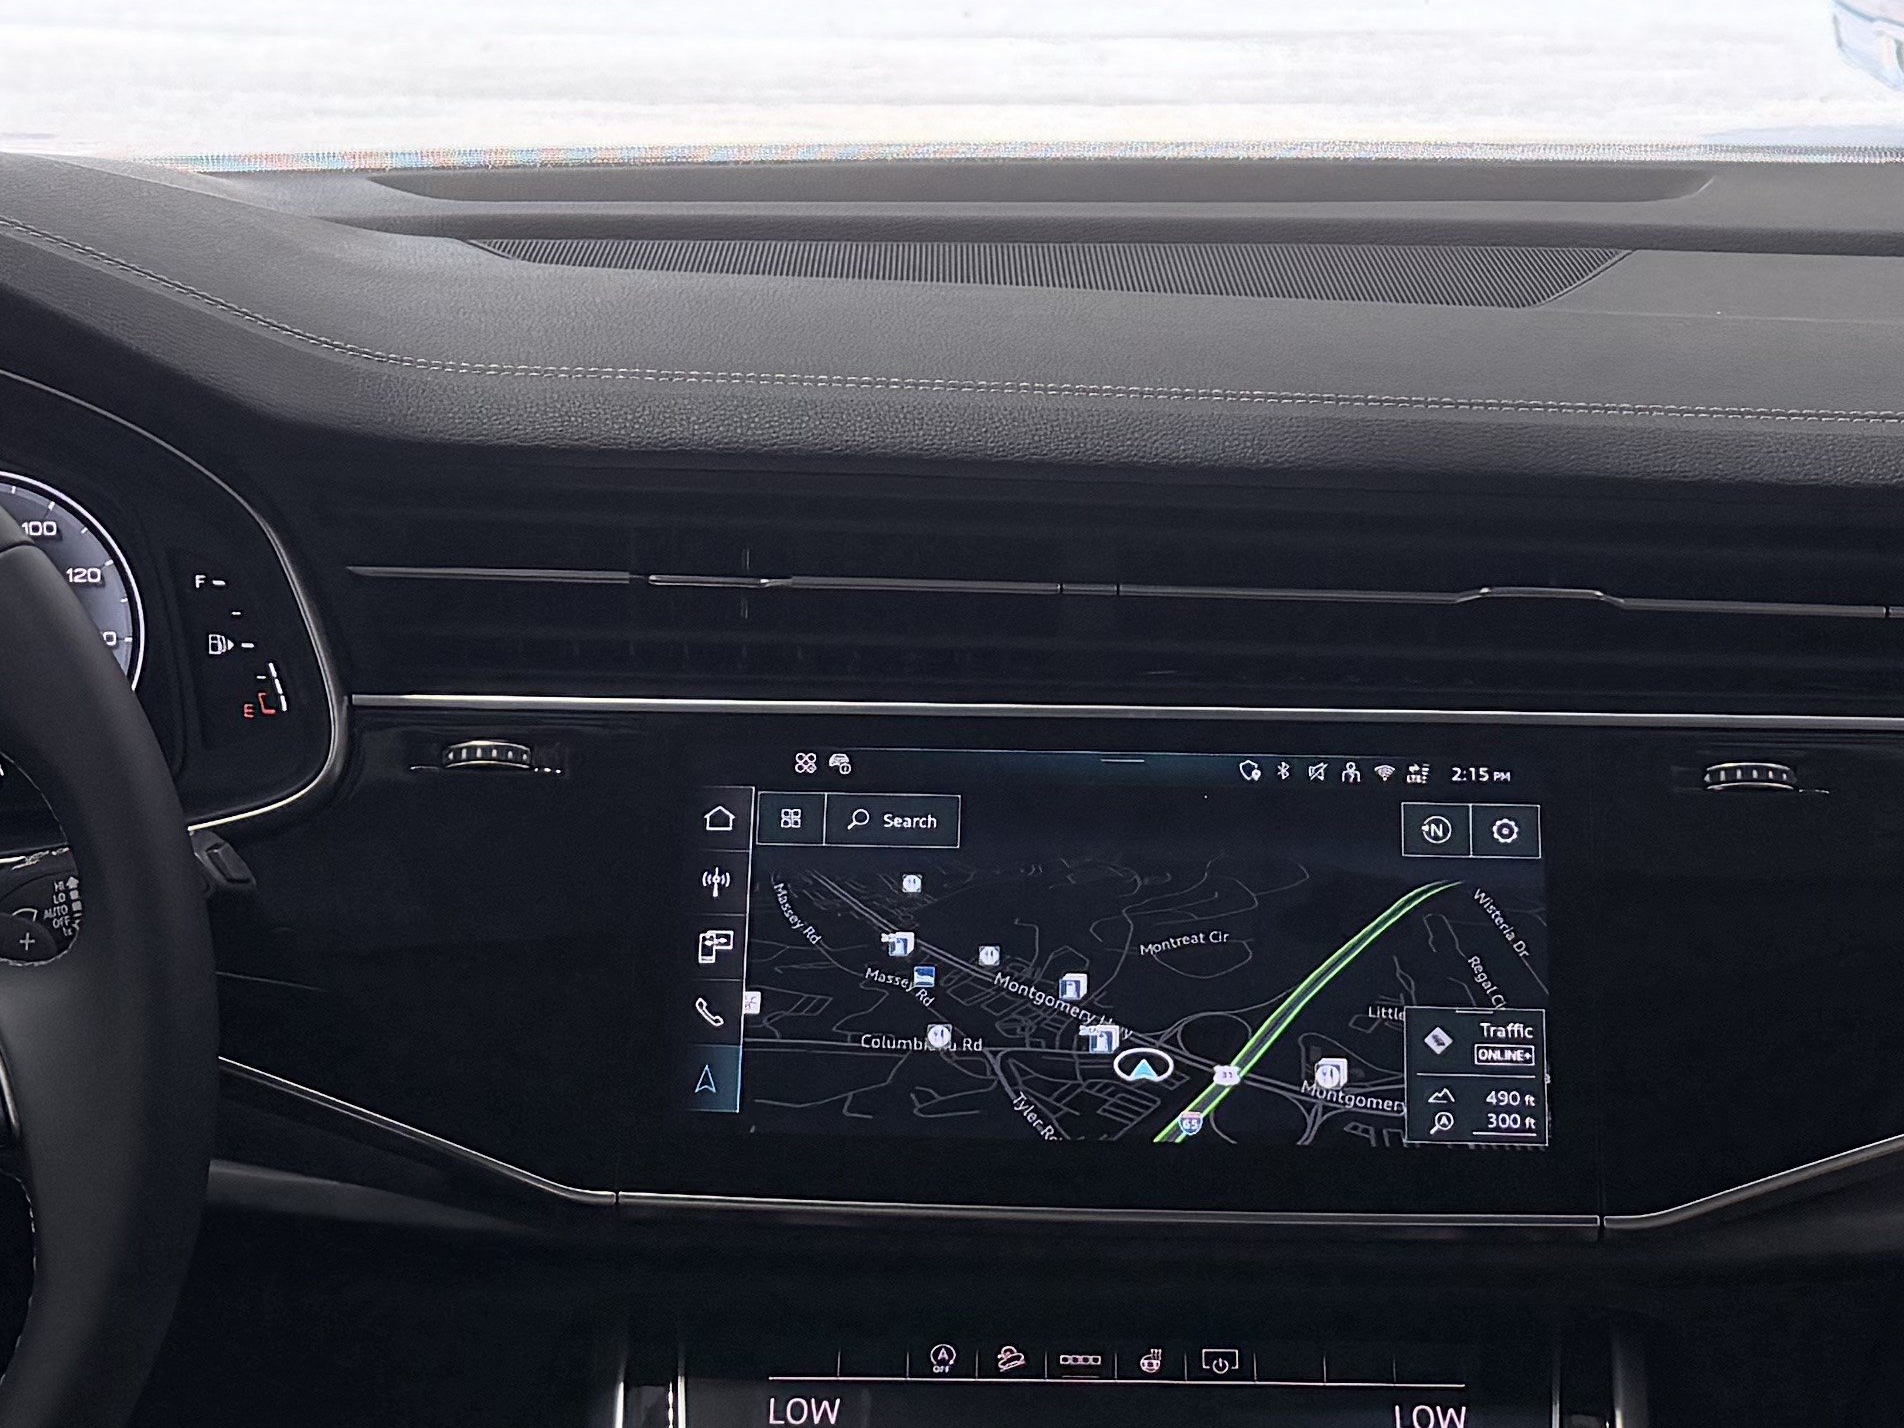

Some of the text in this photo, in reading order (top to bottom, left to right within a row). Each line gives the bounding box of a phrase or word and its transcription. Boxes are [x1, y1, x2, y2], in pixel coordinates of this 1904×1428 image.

[21, 521, 57, 537] 100
[66, 567, 102, 584] 120
[196, 576, 206, 588] F
[244, 704, 255, 718] E
[1452, 767, 1511, 782] 2:15 PM
[883, 813, 937, 829] Search
[773, 882, 822, 945] Massey Rd
[1474, 888, 1530, 958] Wisteria Dr
[1140, 930, 1230, 956] Montreat Cir
[1467, 955, 1498, 996] Regal
[865, 967, 936, 1007] Massey Rd
[994, 972, 1096, 1024] Montgomery
[1479, 1022, 1534, 1039] Traffic
[962, 1036, 983, 1052] Rd
[1478, 1048, 1532, 1062] ONLINE+
[1486, 1090, 1536, 1107] 490 ft
[1012, 1091, 1042, 1129] Tyler
[1487, 1113, 1536, 1130] 300 ft
[768, 1397, 840, 1425] LOW
